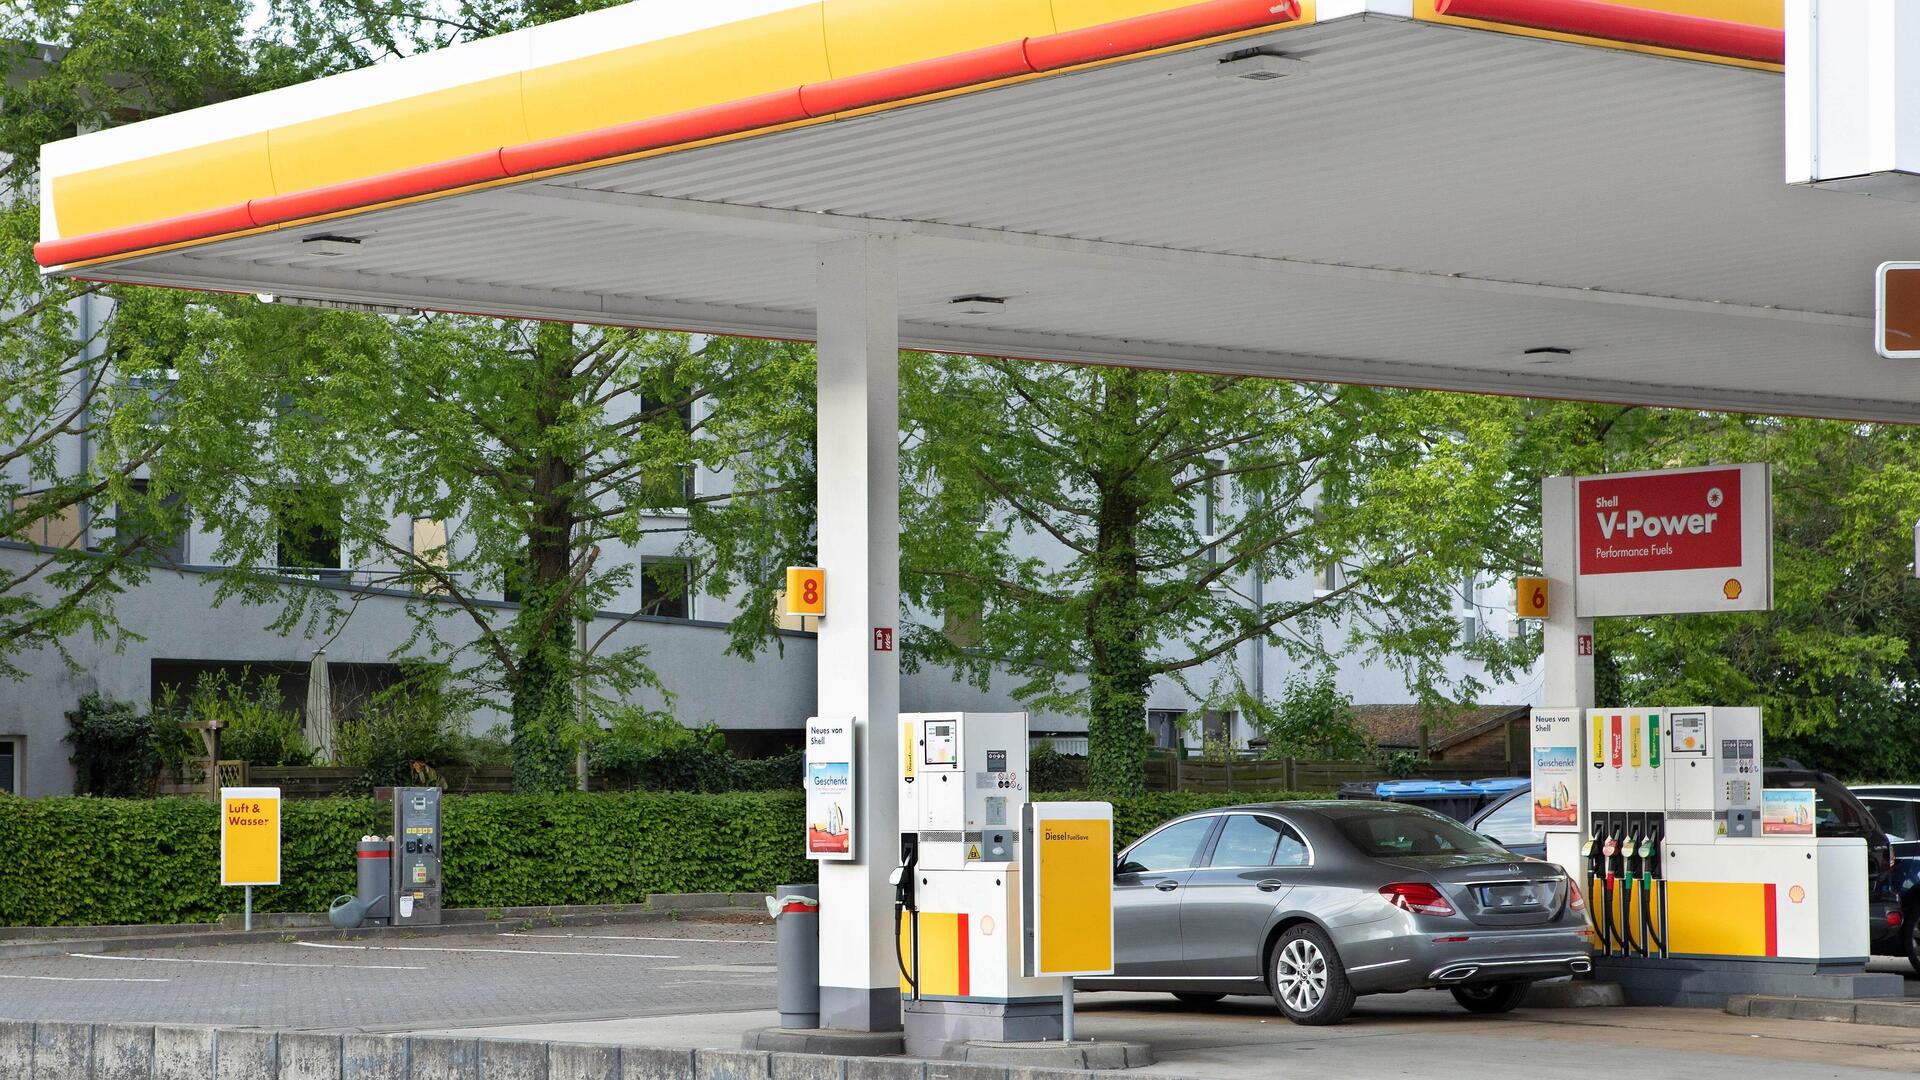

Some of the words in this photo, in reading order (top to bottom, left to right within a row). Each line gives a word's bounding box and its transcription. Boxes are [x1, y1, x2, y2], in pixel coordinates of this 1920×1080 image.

[1596, 496, 1618, 508] Shell
[1596, 510, 1718, 540] V-Power
[1596, 545, 1649, 559] Performance
[1651, 542, 1673, 556] Fuels
[803, 579, 818, 604] 8
[1532, 587, 1545, 609] 6
[811, 727, 830, 735] Neues
[811, 737, 826, 745] Shell
[1537, 758, 1575, 768] Geschenkt
[814, 776, 848, 786] Geschenkt
[229, 803, 250, 813] Luft
[252, 803, 261, 813] &
[229, 816, 270, 826] Wasser
[1045, 832, 1067, 841] Diesel
